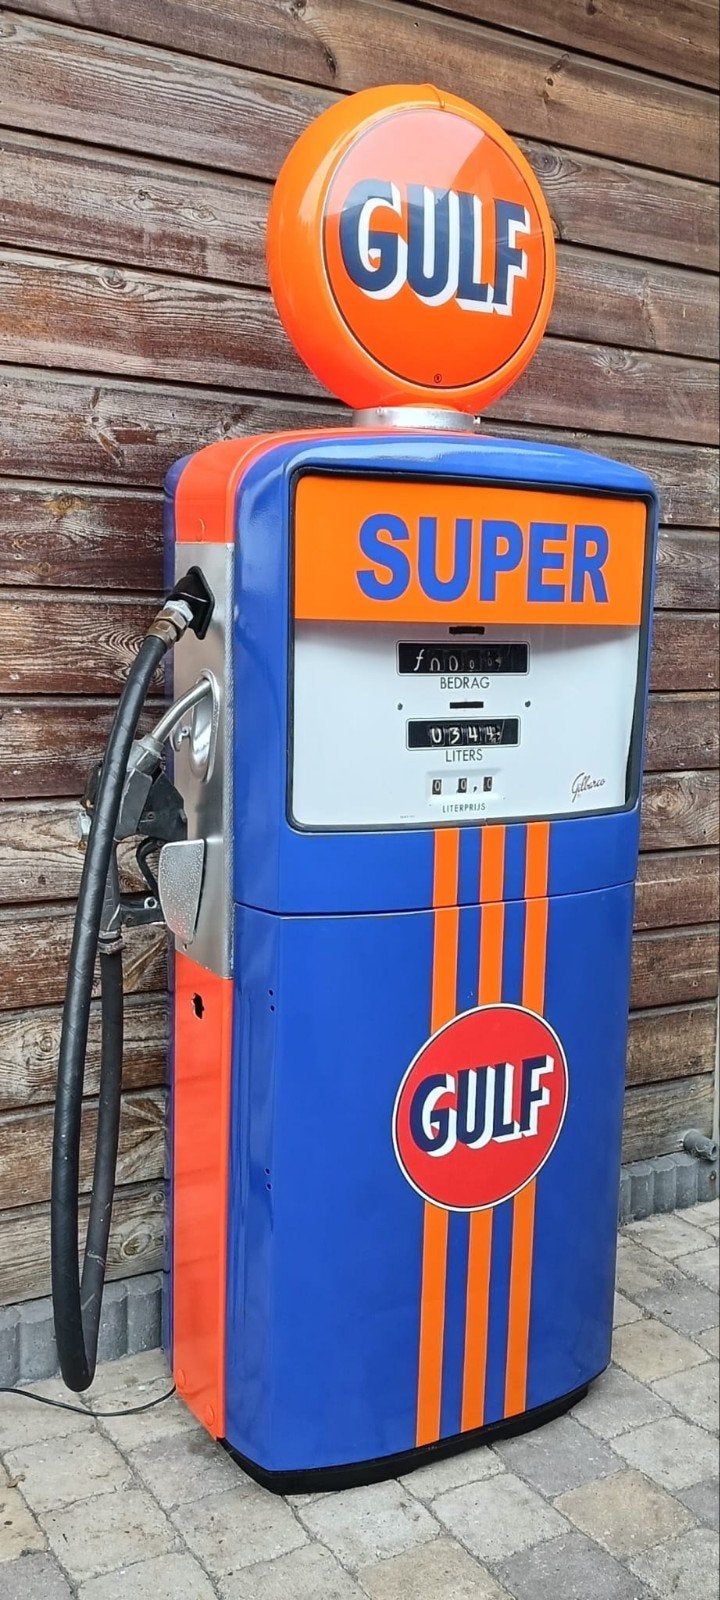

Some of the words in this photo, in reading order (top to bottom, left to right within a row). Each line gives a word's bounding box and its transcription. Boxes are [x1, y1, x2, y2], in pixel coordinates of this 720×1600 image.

[339, 178, 530, 317] GULF
[356, 513, 609, 603] SUPER
[440, 677, 490, 689] BEDRAG
[445, 749, 483, 762] LITERS
[442, 803, 486, 813] LITERPRIJS
[409, 1054, 554, 1158] GULF
